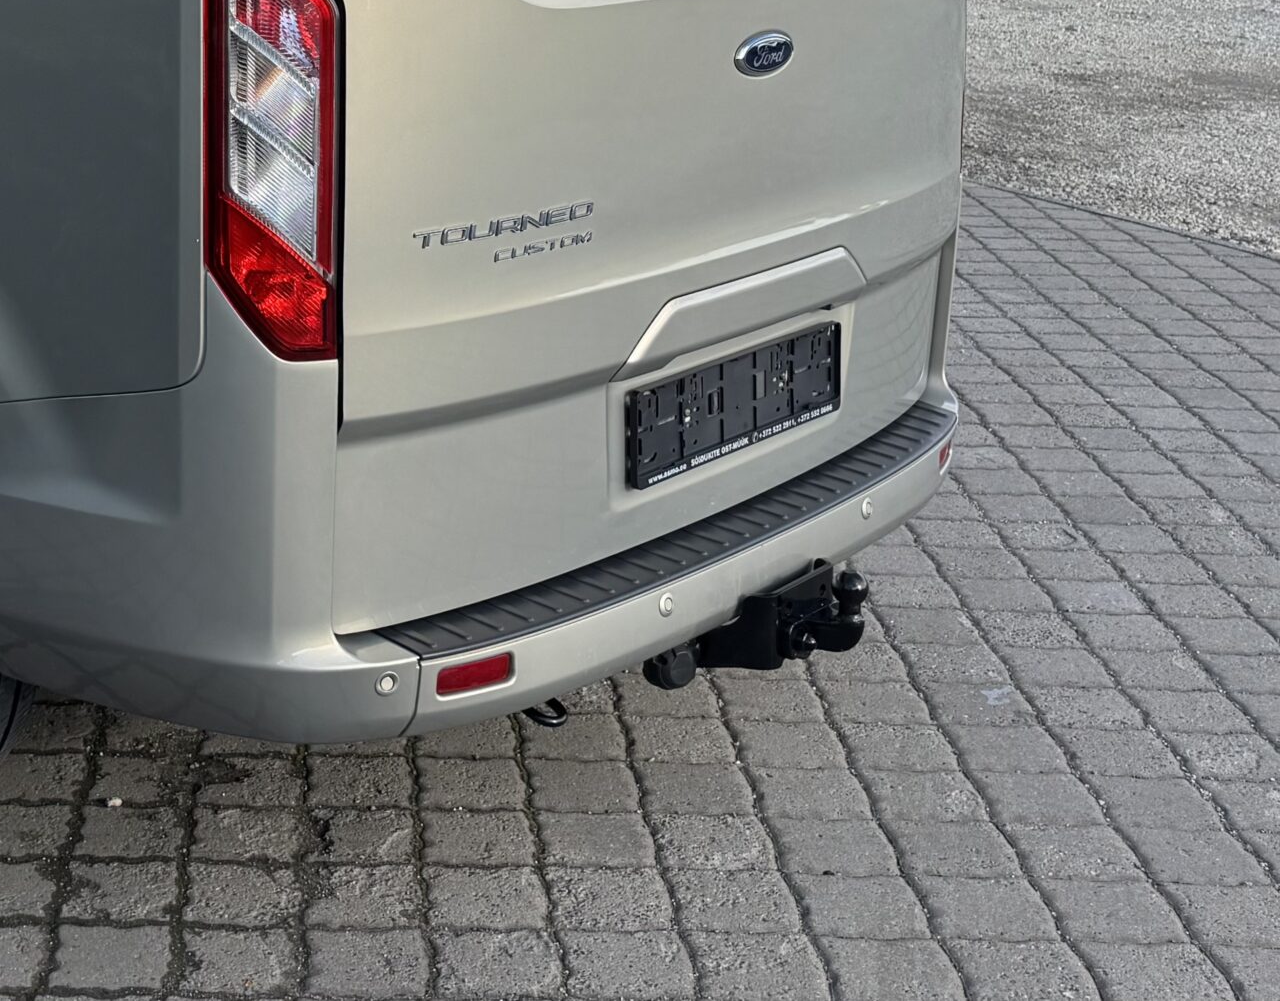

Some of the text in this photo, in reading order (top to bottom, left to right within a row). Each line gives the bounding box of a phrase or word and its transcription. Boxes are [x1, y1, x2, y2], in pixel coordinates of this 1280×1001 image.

[753, 41, 785, 67] Ford
[412, 201, 594, 249] TOURNEO
[493, 230, 593, 263] CUSTOM
